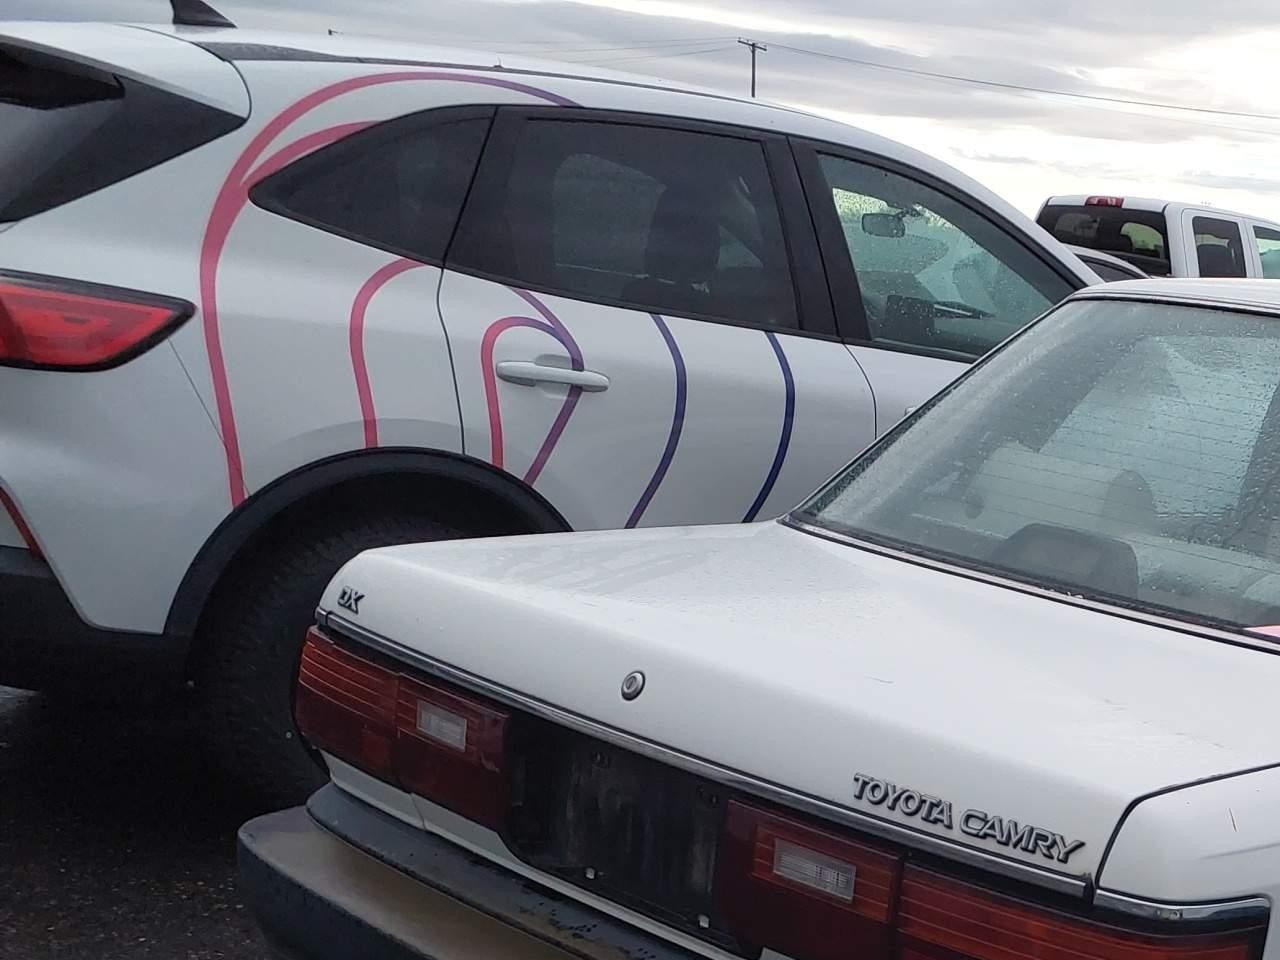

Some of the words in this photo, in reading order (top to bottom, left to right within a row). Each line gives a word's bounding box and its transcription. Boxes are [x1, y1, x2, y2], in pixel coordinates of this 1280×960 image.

[337, 586, 365, 615] DX
[853, 772, 953, 829] TOYOTA
[959, 808, 1086, 864] CAMRY
